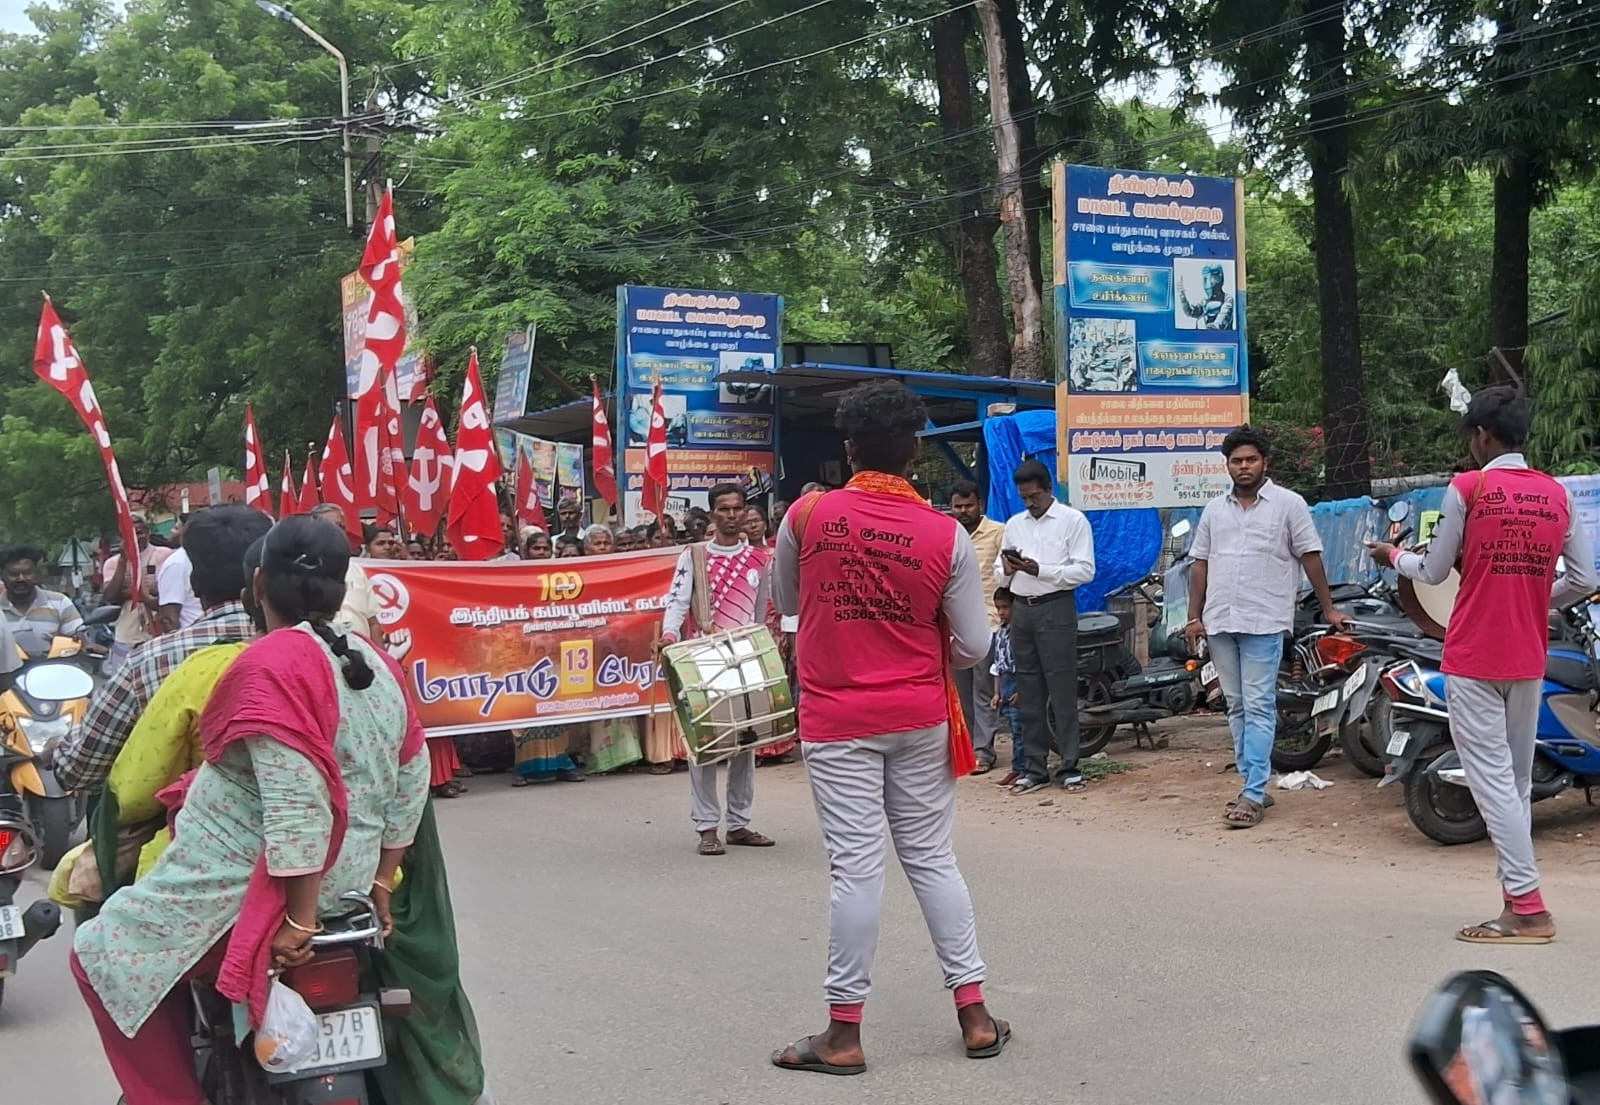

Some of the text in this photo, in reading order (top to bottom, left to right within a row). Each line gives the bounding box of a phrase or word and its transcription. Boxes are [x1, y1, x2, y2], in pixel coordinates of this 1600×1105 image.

[1108, 174, 1194, 198] திண்டுக்கல்
[1077, 198, 1223, 227] மாவட்ட காவல்துறை
[1072, 222, 1105, 234] சாலை
[1111, 240, 1161, 255] வாழ்க்கை
[663, 293, 740, 310] திண்டுக்கல்
[1096, 465, 1139, 482] Mobile
[860, 527, 914, 549] குணா
[1504, 529, 1519, 538] TN
[1480, 540, 1552, 553] KARTHI NAGA
[844, 569, 865, 580] TN
[537, 571, 584, 602] 100
[819, 581, 868, 594] KARTHI
[449, 604, 530, 627] இந்தியக்
[533, 598, 633, 621] கம்யூனிஸ்ட்
[565, 648, 589, 672] 13
[413, 656, 559, 717] மாநாடு
